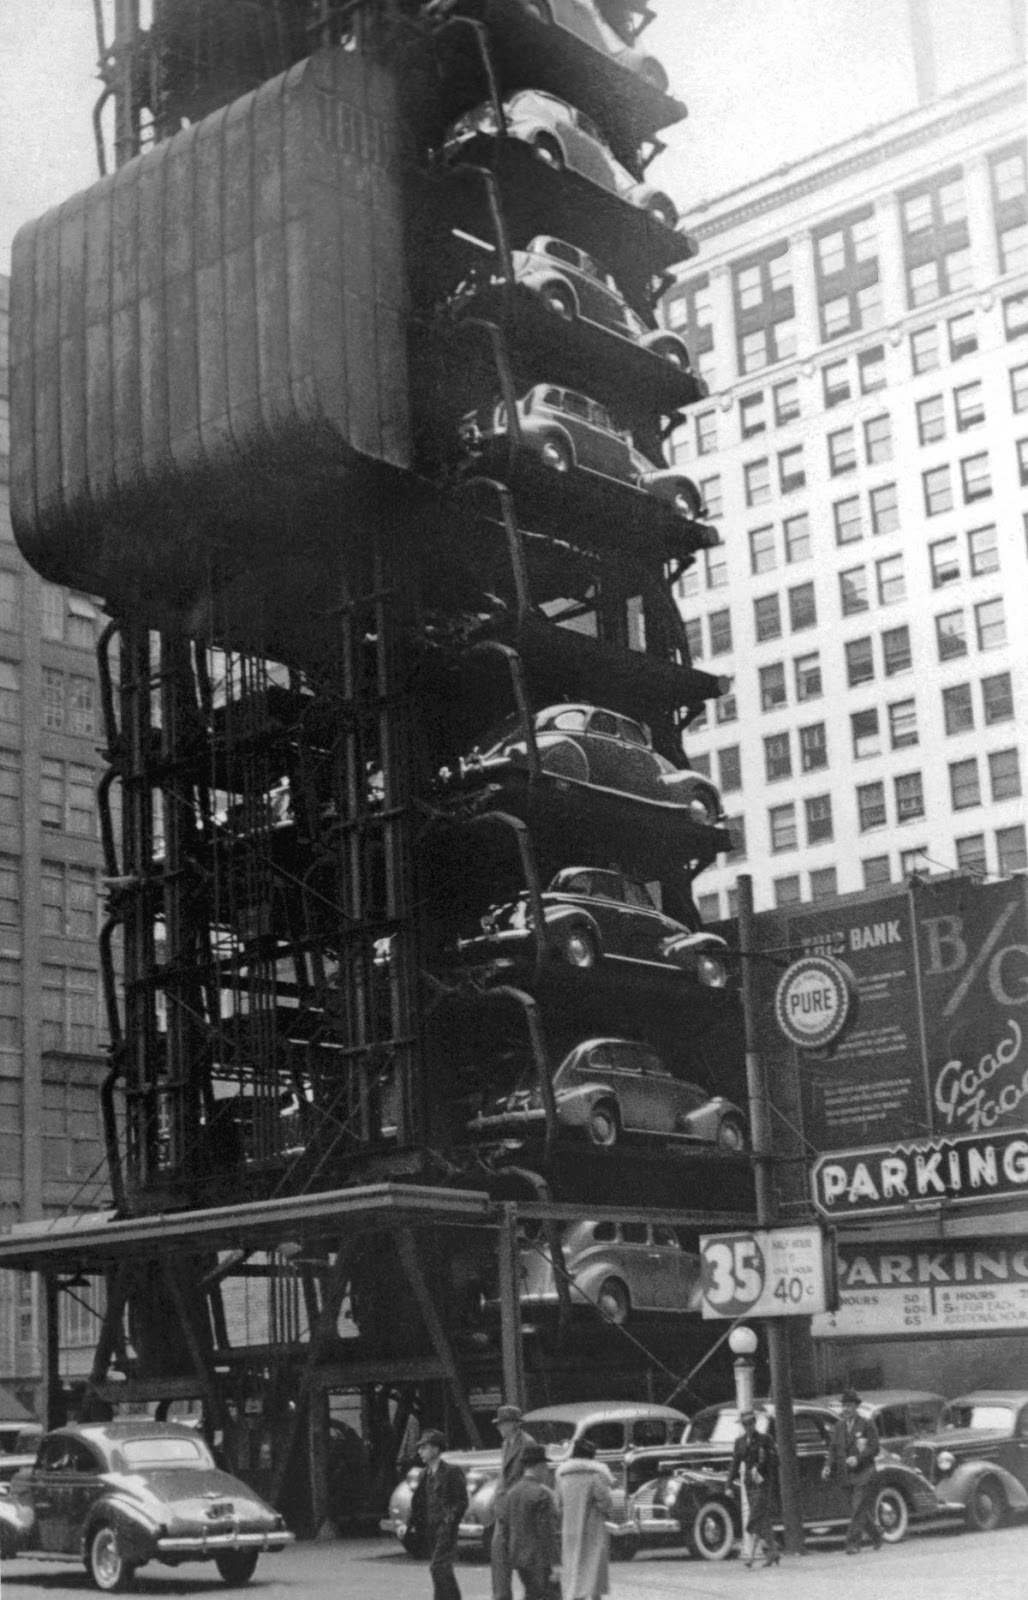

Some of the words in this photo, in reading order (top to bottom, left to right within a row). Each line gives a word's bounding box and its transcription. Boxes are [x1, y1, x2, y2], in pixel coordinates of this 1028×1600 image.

[850, 920, 902, 951] BANK
[790, 988, 833, 1016] PURE
[934, 1019, 1022, 1124] Good
[823, 1140, 1028, 1205] PARKING
